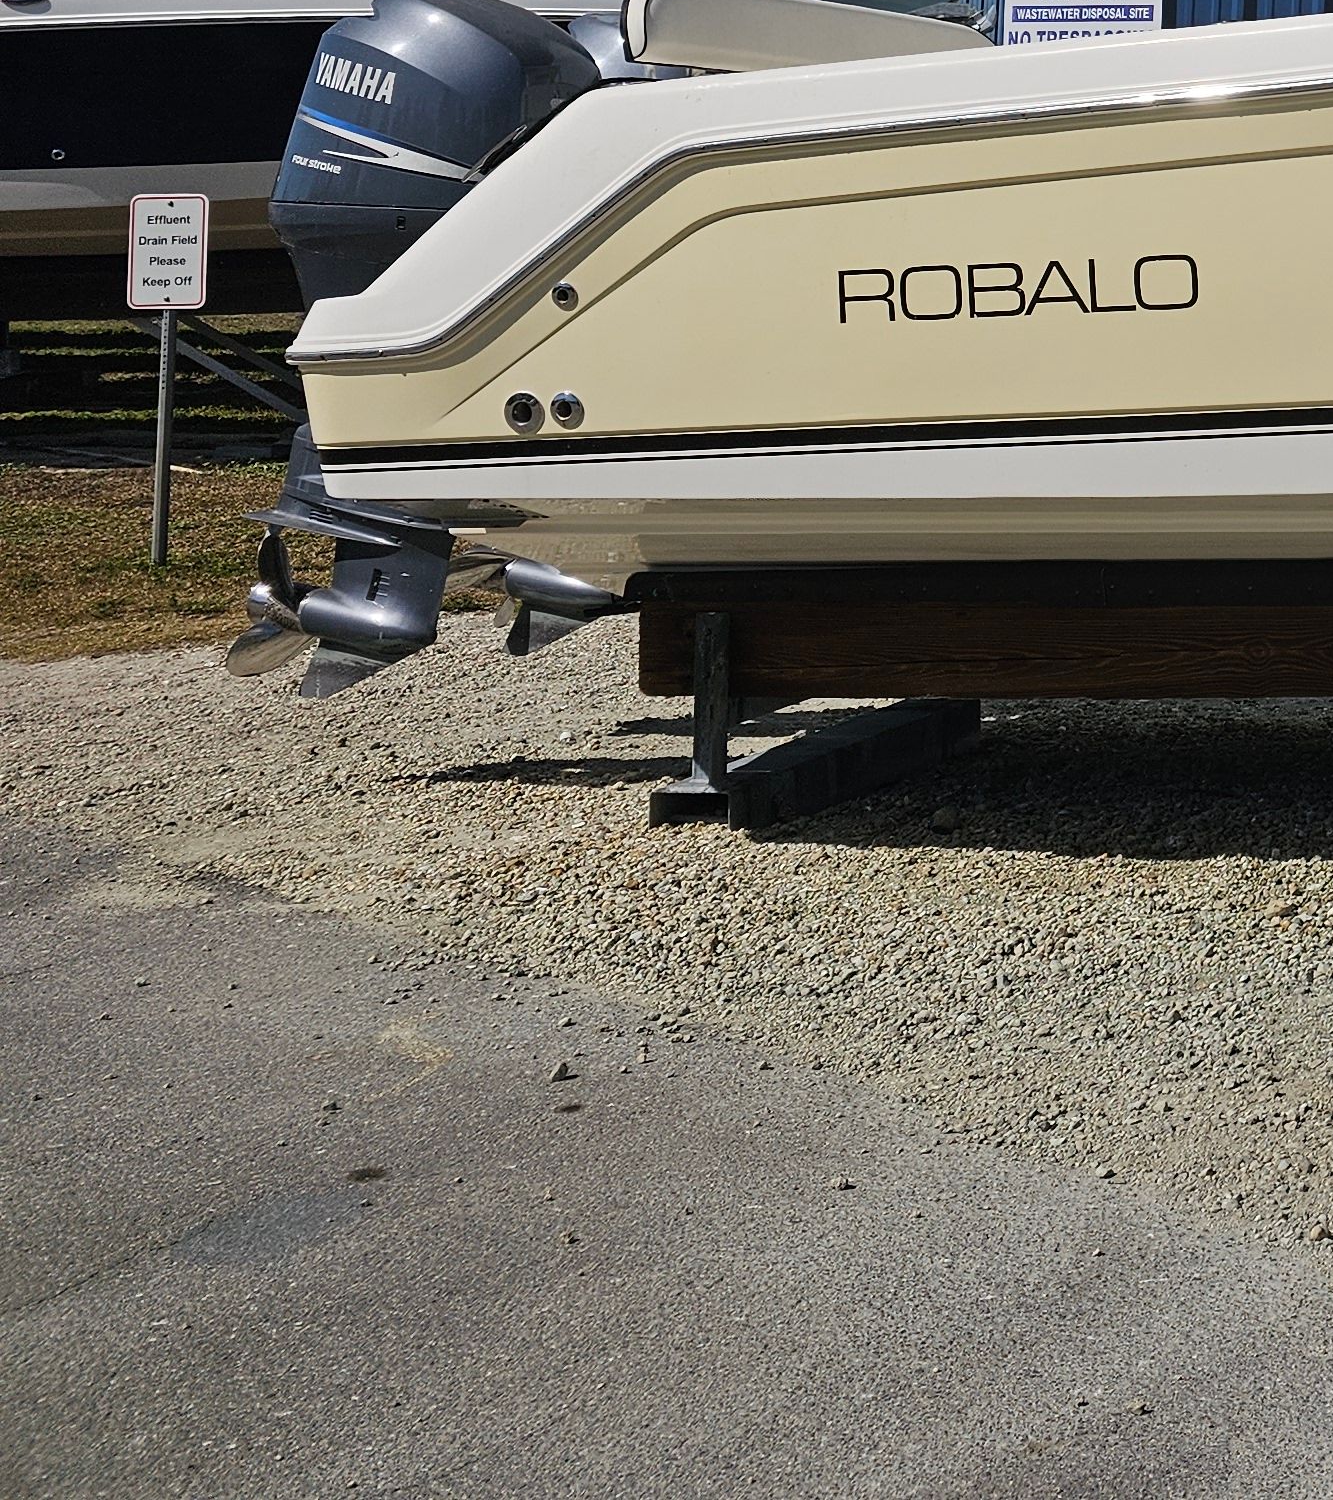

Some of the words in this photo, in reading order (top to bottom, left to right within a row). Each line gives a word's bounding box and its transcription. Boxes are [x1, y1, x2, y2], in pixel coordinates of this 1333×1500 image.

[1016, 8, 1080, 20] WASTEWATER
[1081, 7, 1128, 19] DISPOSAL
[1129, 7, 1150, 19] SITE
[315, 52, 396, 105] YAMAHA
[147, 215, 191, 225] Effluent
[138, 236, 168, 246] Drain
[171, 235, 198, 245] Field
[149, 256, 187, 266] Please
[142, 277, 171, 288] Keep
[174, 276, 193, 286] Off
[838, 254, 1199, 323] ROBALO
